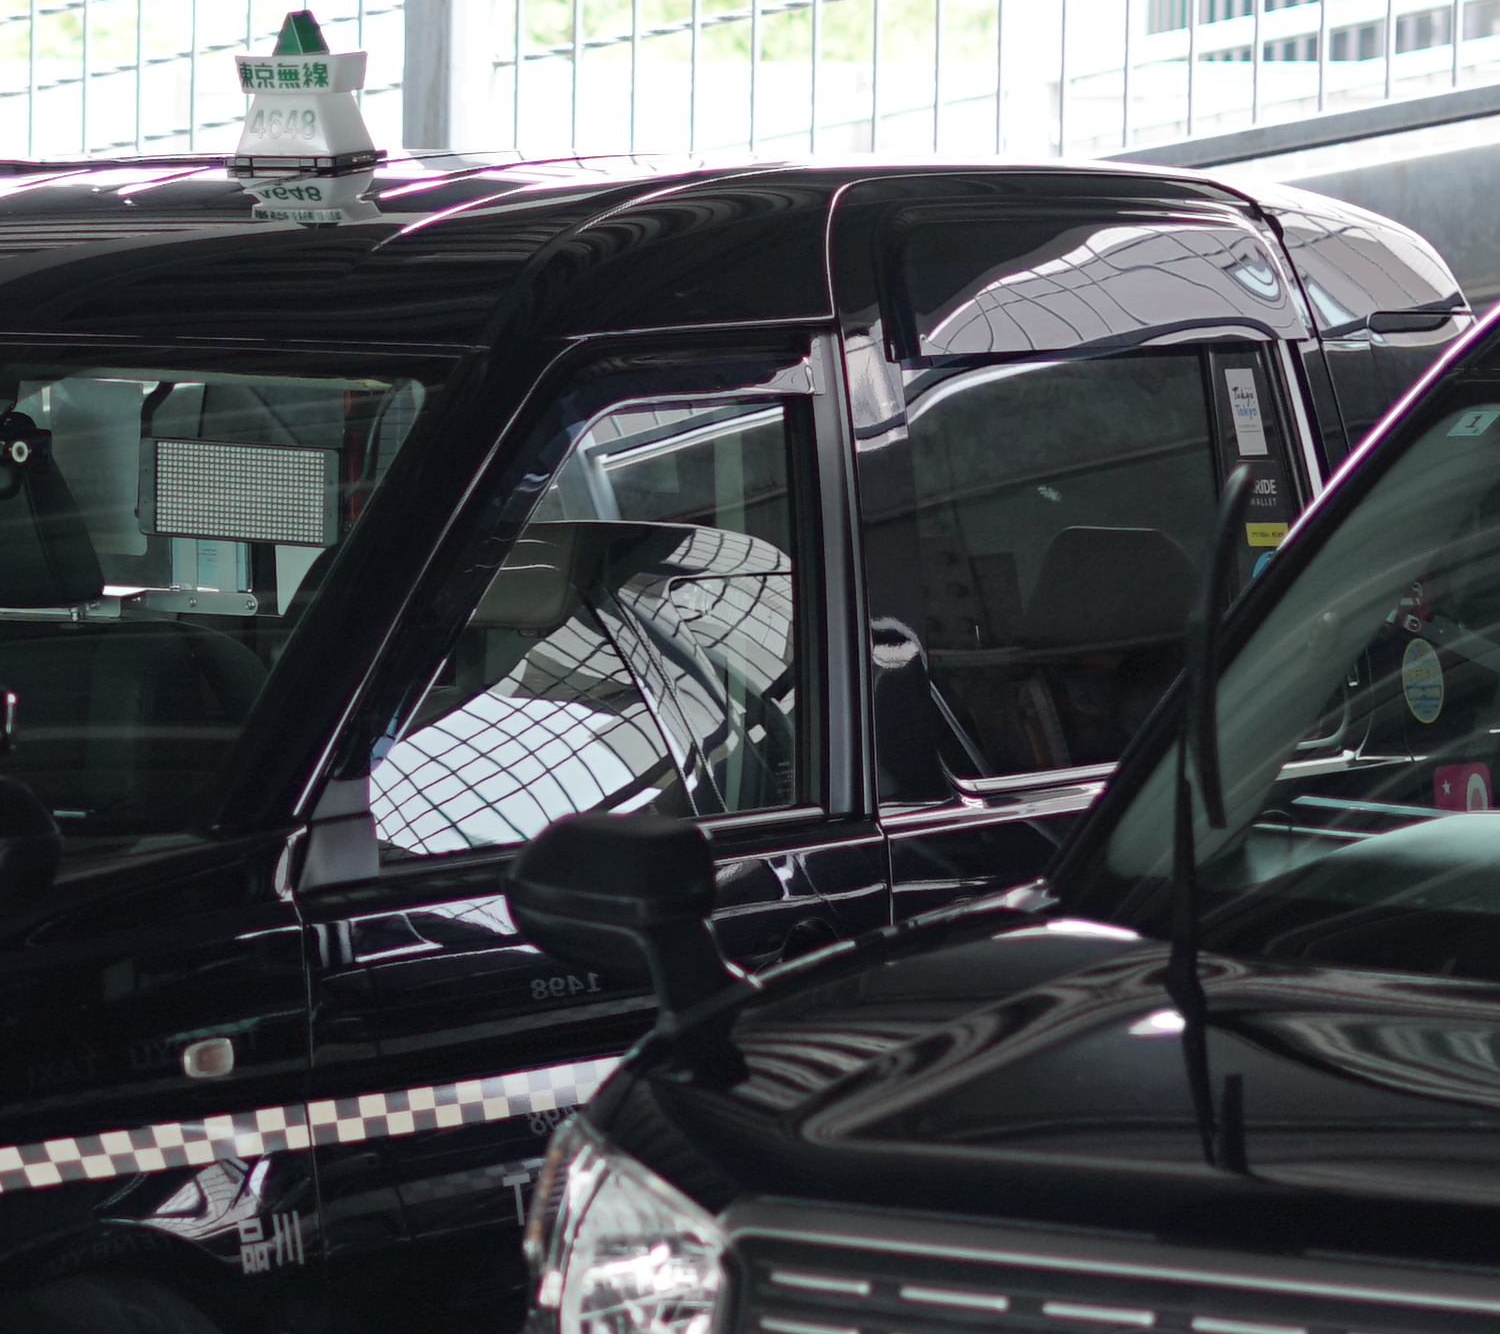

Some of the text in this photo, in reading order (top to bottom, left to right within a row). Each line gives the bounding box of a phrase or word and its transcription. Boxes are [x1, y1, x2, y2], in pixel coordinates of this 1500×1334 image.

[239, 61, 329, 89] 東京無線
[250, 109, 316, 140] 4648
[1252, 479, 1277, 495] RIDE
[237, 1210, 305, 1275] 品川
